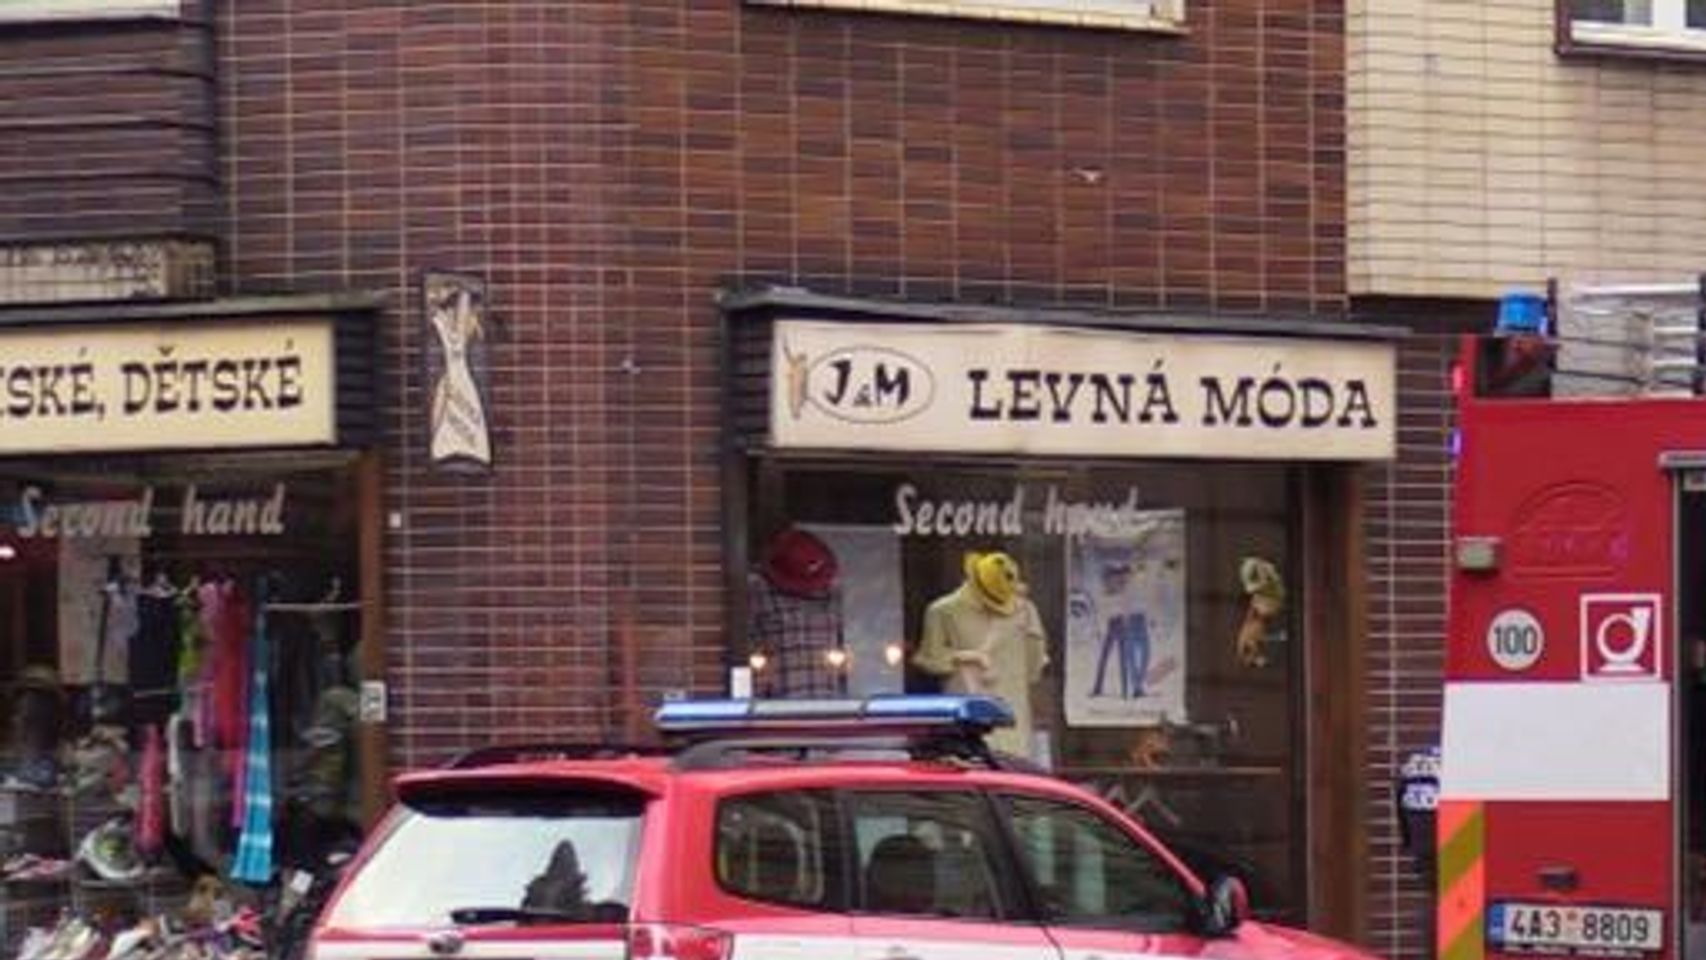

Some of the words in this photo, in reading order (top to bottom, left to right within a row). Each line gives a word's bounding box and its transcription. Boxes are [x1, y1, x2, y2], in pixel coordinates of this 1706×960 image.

[0, 347, 105, 420] SKÉ,
[121, 338, 304, 414] DĚTSKÉ
[967, 358, 1179, 423] LEVNÁ
[1199, 361, 1378, 429] MÓDA
[17, 487, 154, 537] Second
[181, 482, 286, 535] hand
[893, 483, 1023, 535] Second
[1494, 626, 1538, 655] 100
[1511, 910, 1562, 938] 4A3
[1582, 914, 1648, 941] 8809
